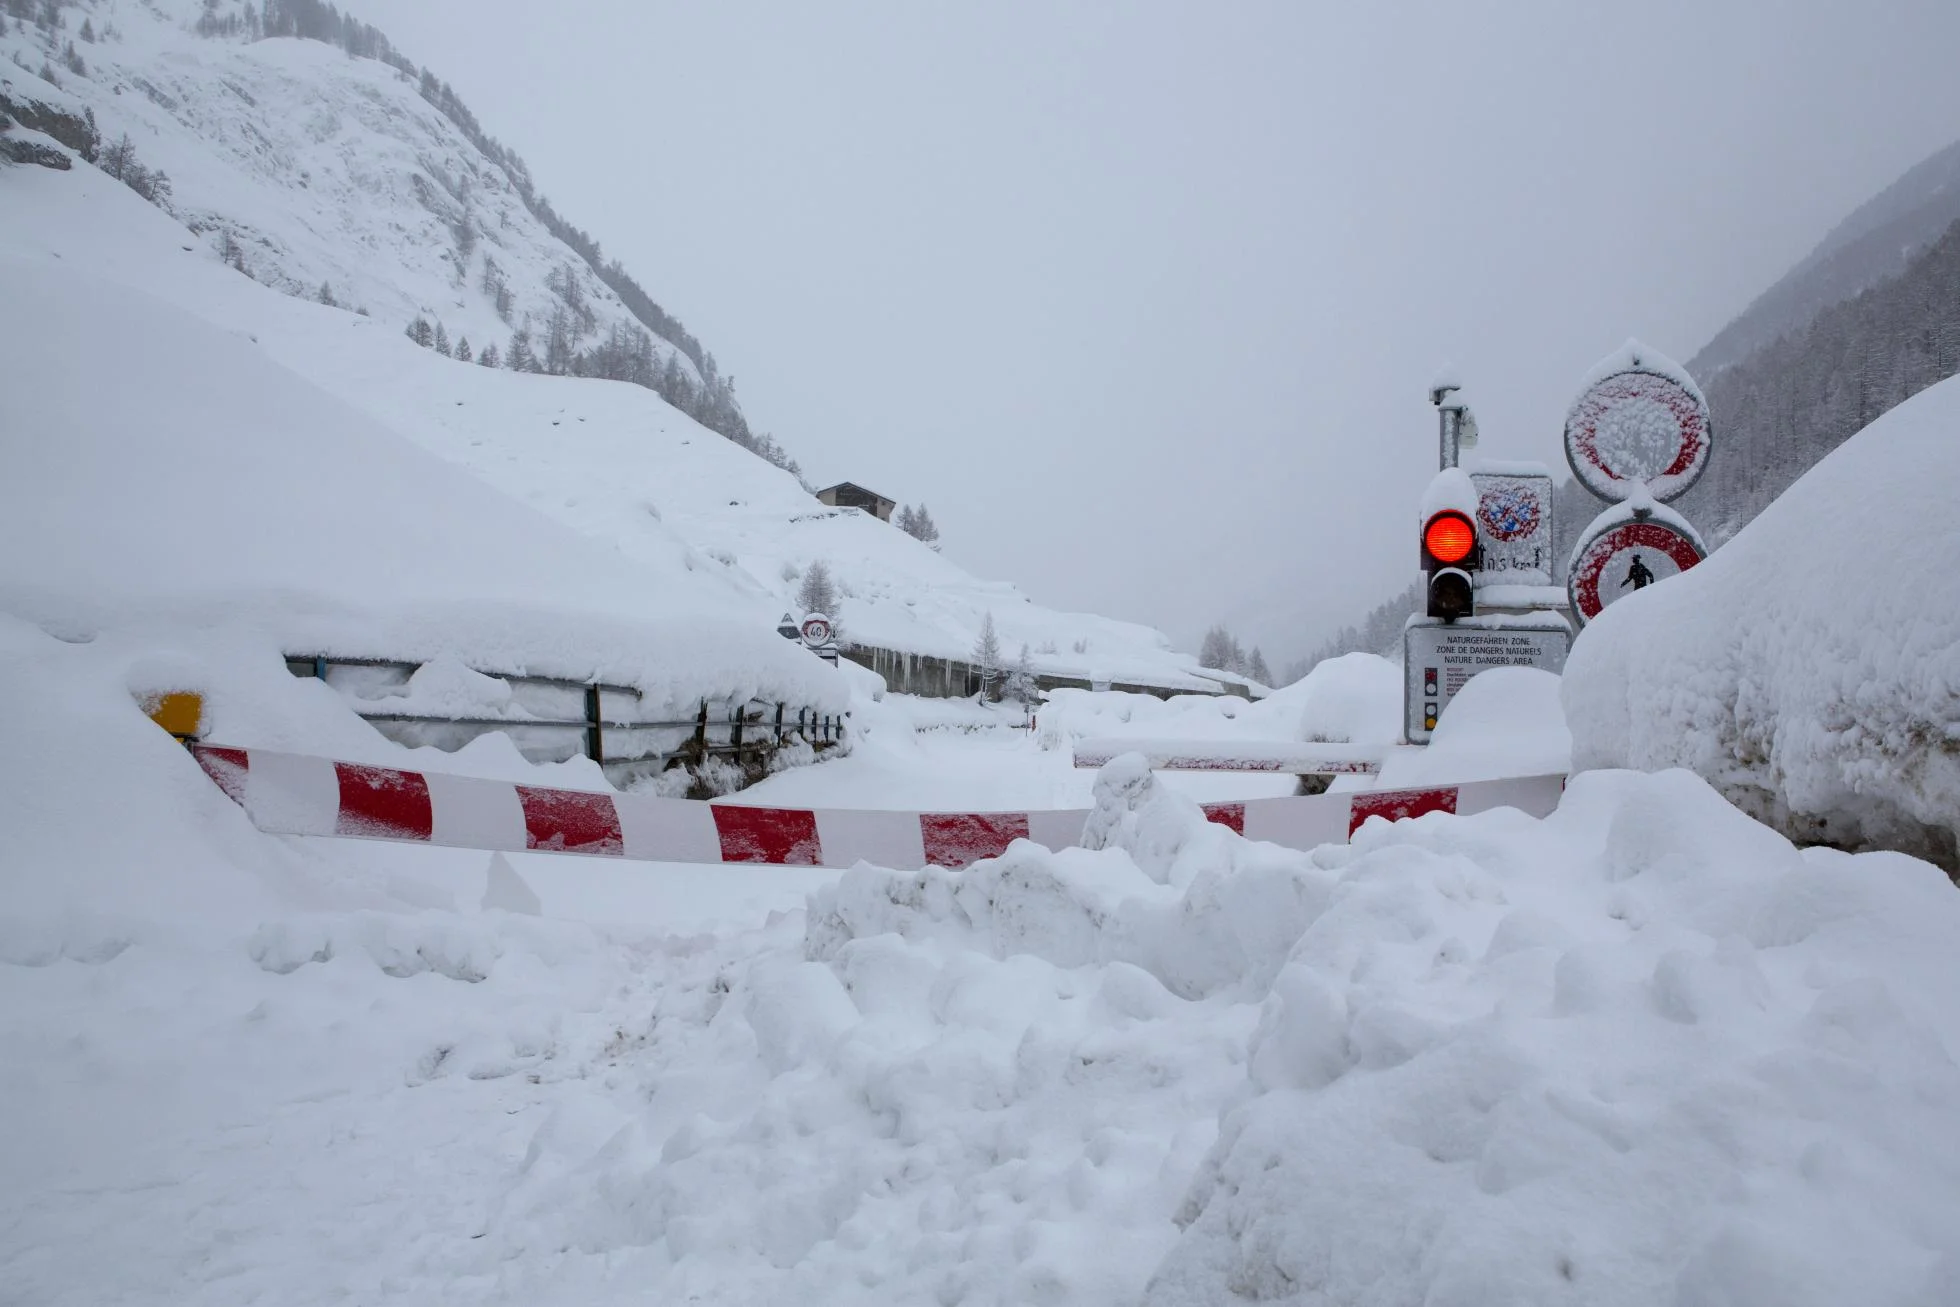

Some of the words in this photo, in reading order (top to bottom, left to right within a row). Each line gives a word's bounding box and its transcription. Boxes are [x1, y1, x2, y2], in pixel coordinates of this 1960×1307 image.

[810, 626, 822, 637] 40
[1447, 636, 1508, 645] NATURGEFAHREN
[1511, 637, 1531, 646] ZONE
[1436, 646, 1456, 654] ZONE
[1458, 646, 1468, 654] DE
[1470, 646, 1504, 655] DANGERS
[1506, 647, 1542, 656] NATURELS
[1444, 656, 1472, 664] NATURE
[1476, 657, 1510, 665] DANGERS
[1513, 657, 1533, 665] AREA
